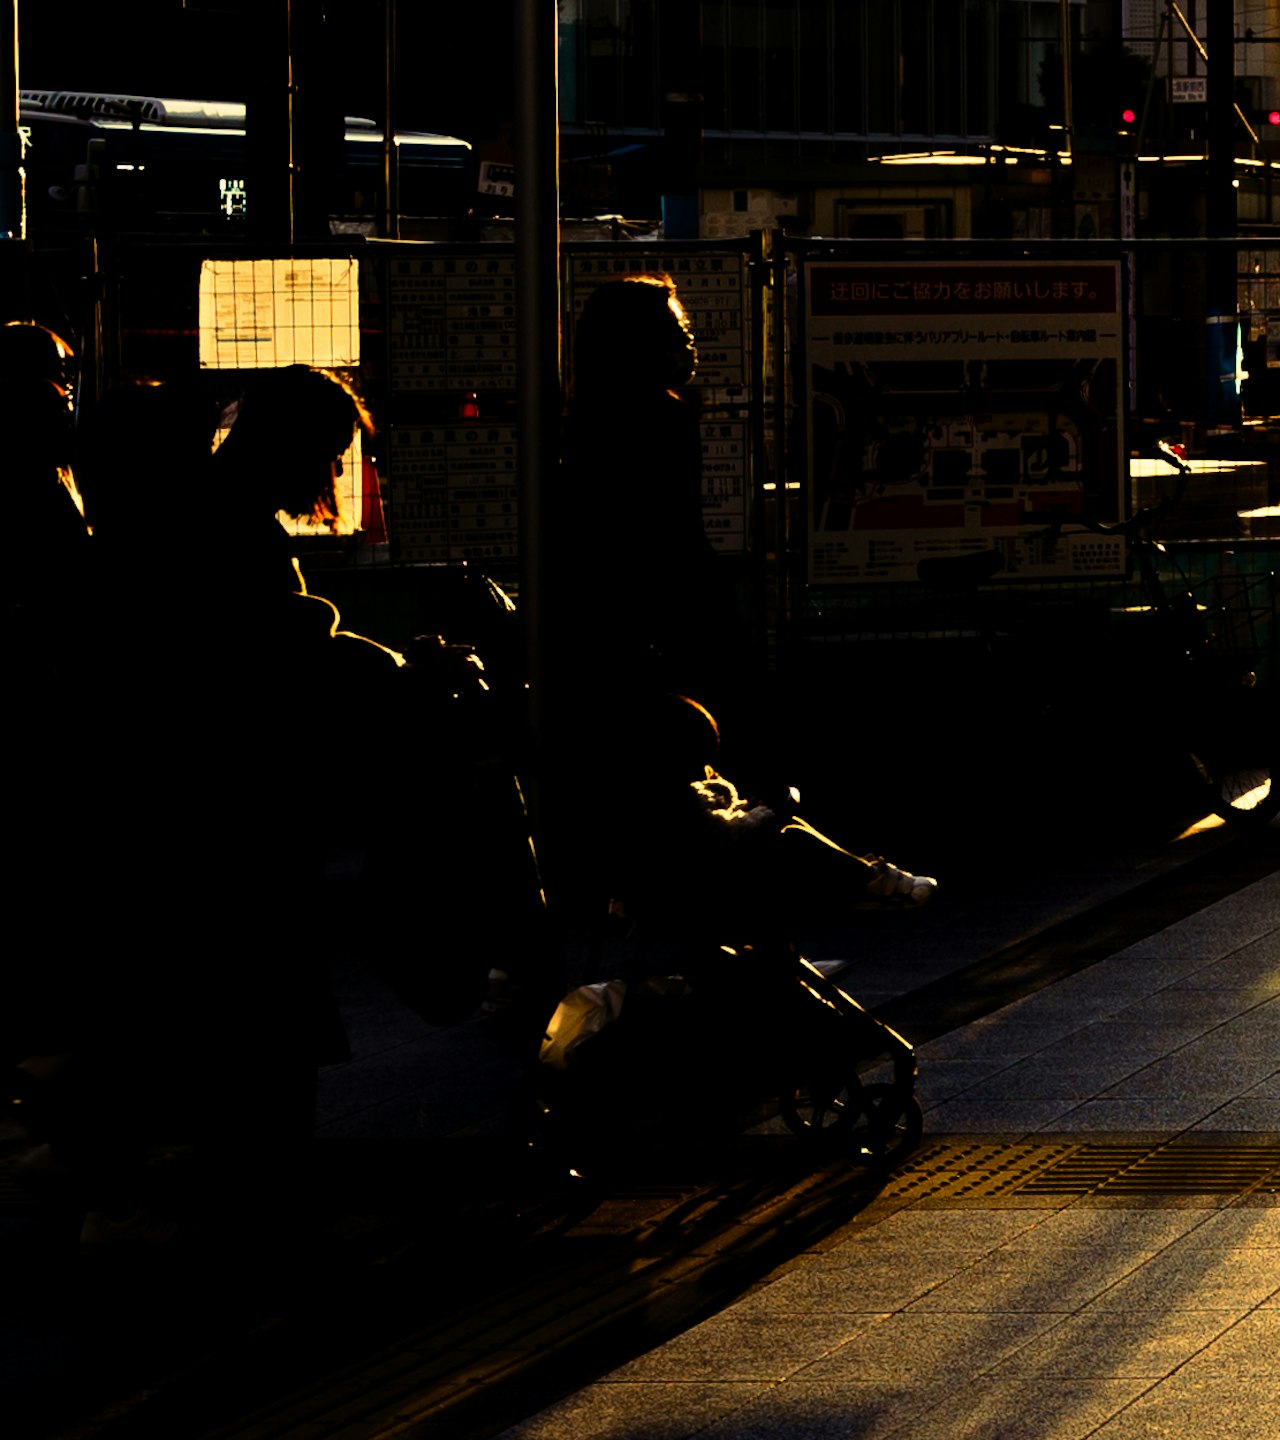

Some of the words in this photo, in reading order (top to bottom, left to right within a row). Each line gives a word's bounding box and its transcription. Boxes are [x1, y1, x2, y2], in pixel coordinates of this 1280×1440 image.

[829, 280, 1098, 302] 迂回にご協力をお願いします。
